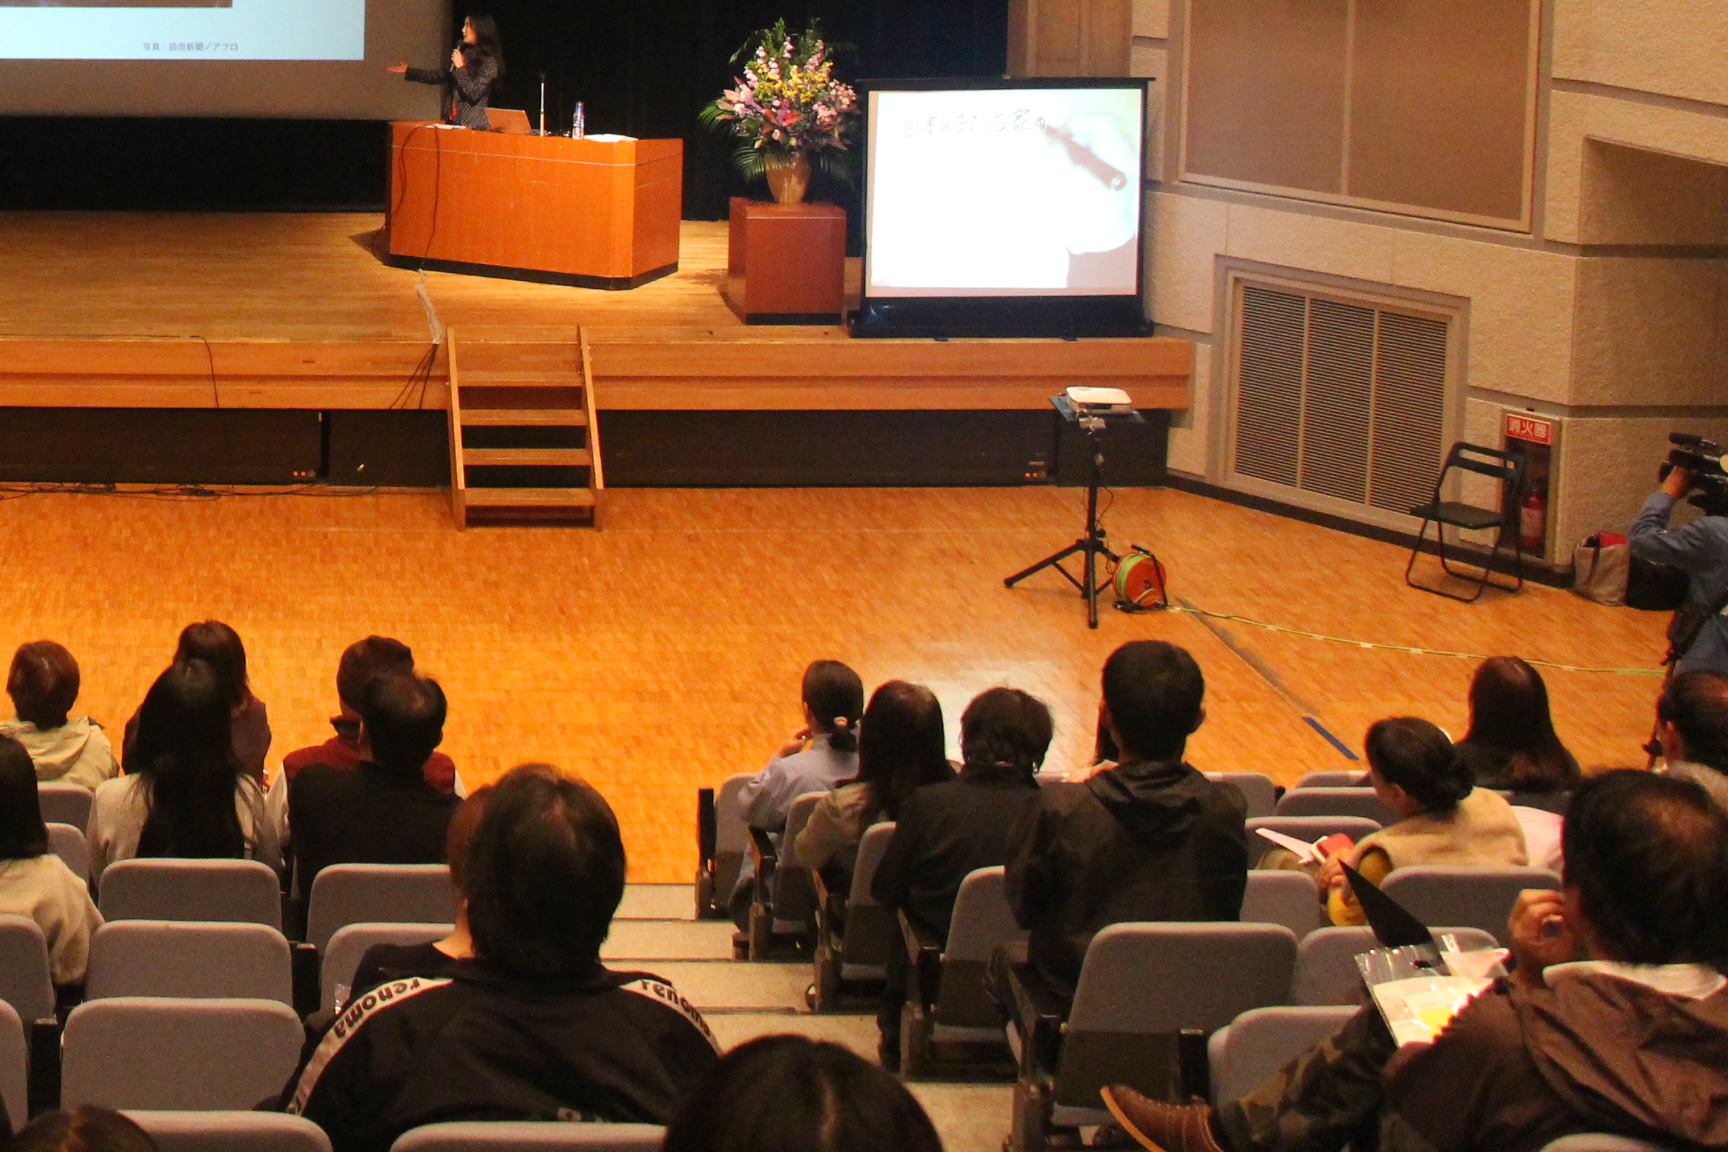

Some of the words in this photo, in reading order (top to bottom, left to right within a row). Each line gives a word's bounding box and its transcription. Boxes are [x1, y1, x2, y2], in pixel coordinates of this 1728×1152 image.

[1508, 417, 1548, 438] 消火器
[334, 978, 422, 1039] renoma
